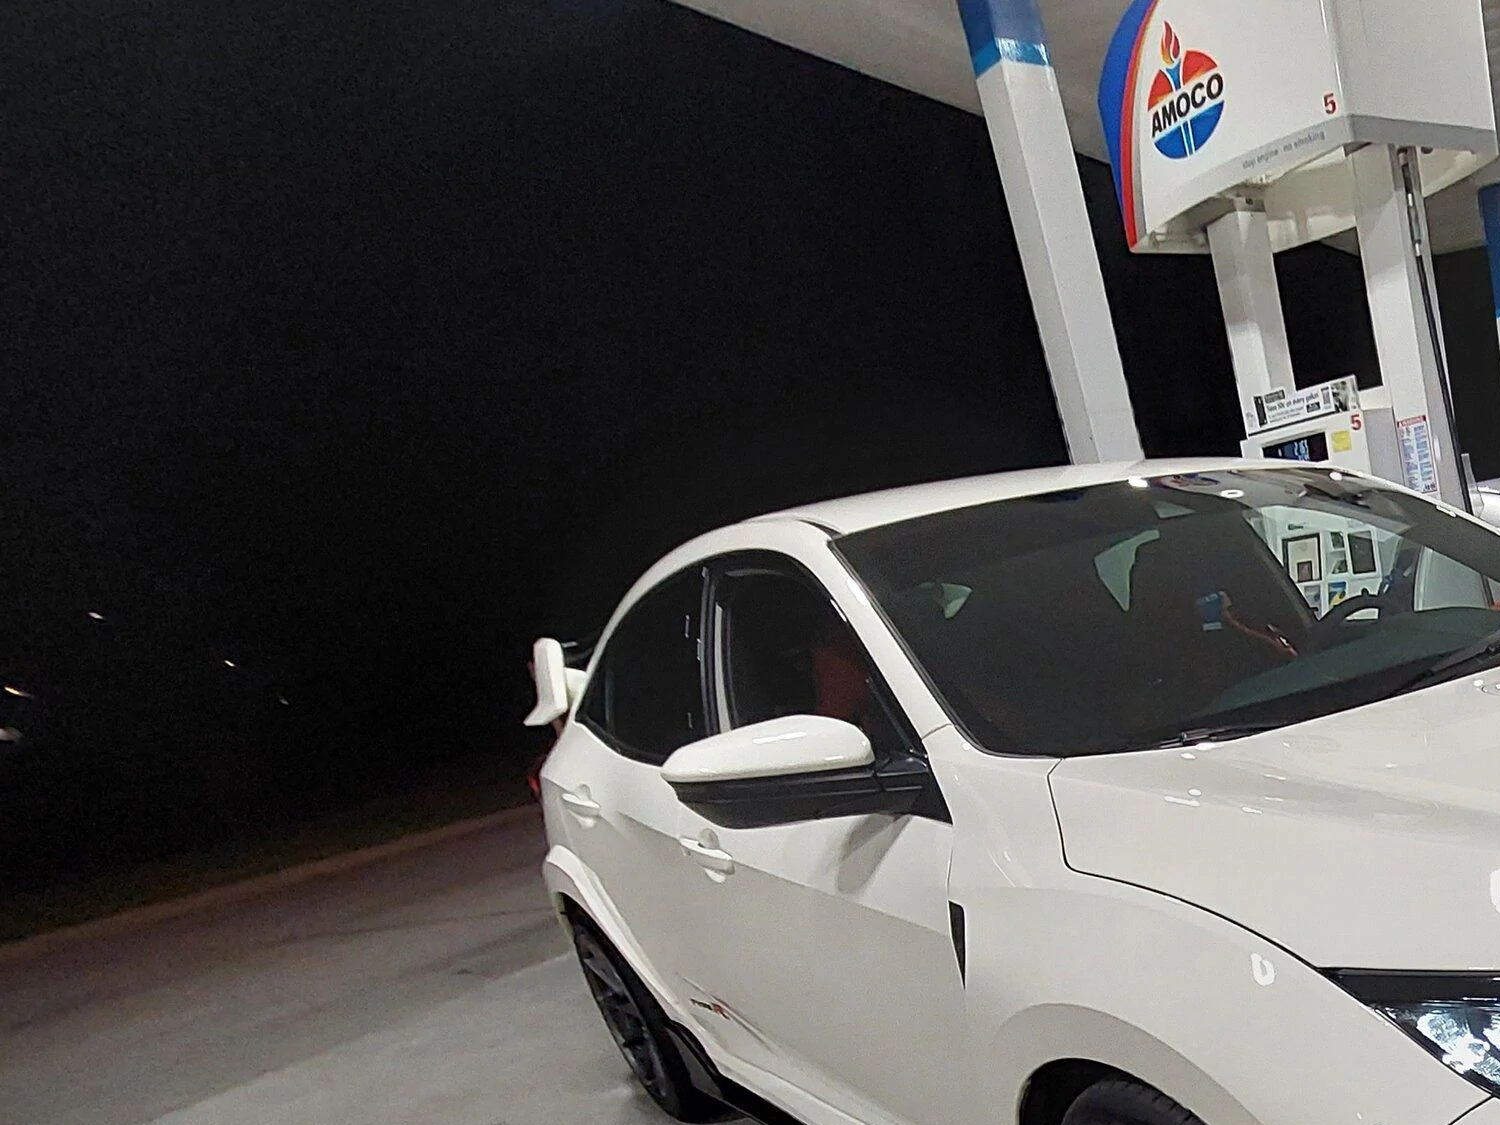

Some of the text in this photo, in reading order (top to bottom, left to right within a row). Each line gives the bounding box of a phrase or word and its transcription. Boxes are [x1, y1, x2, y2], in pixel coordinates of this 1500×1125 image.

[1152, 73, 1224, 137] AMOCO
[1323, 93, 1337, 114] 5
[1351, 414, 1361, 430] 5
